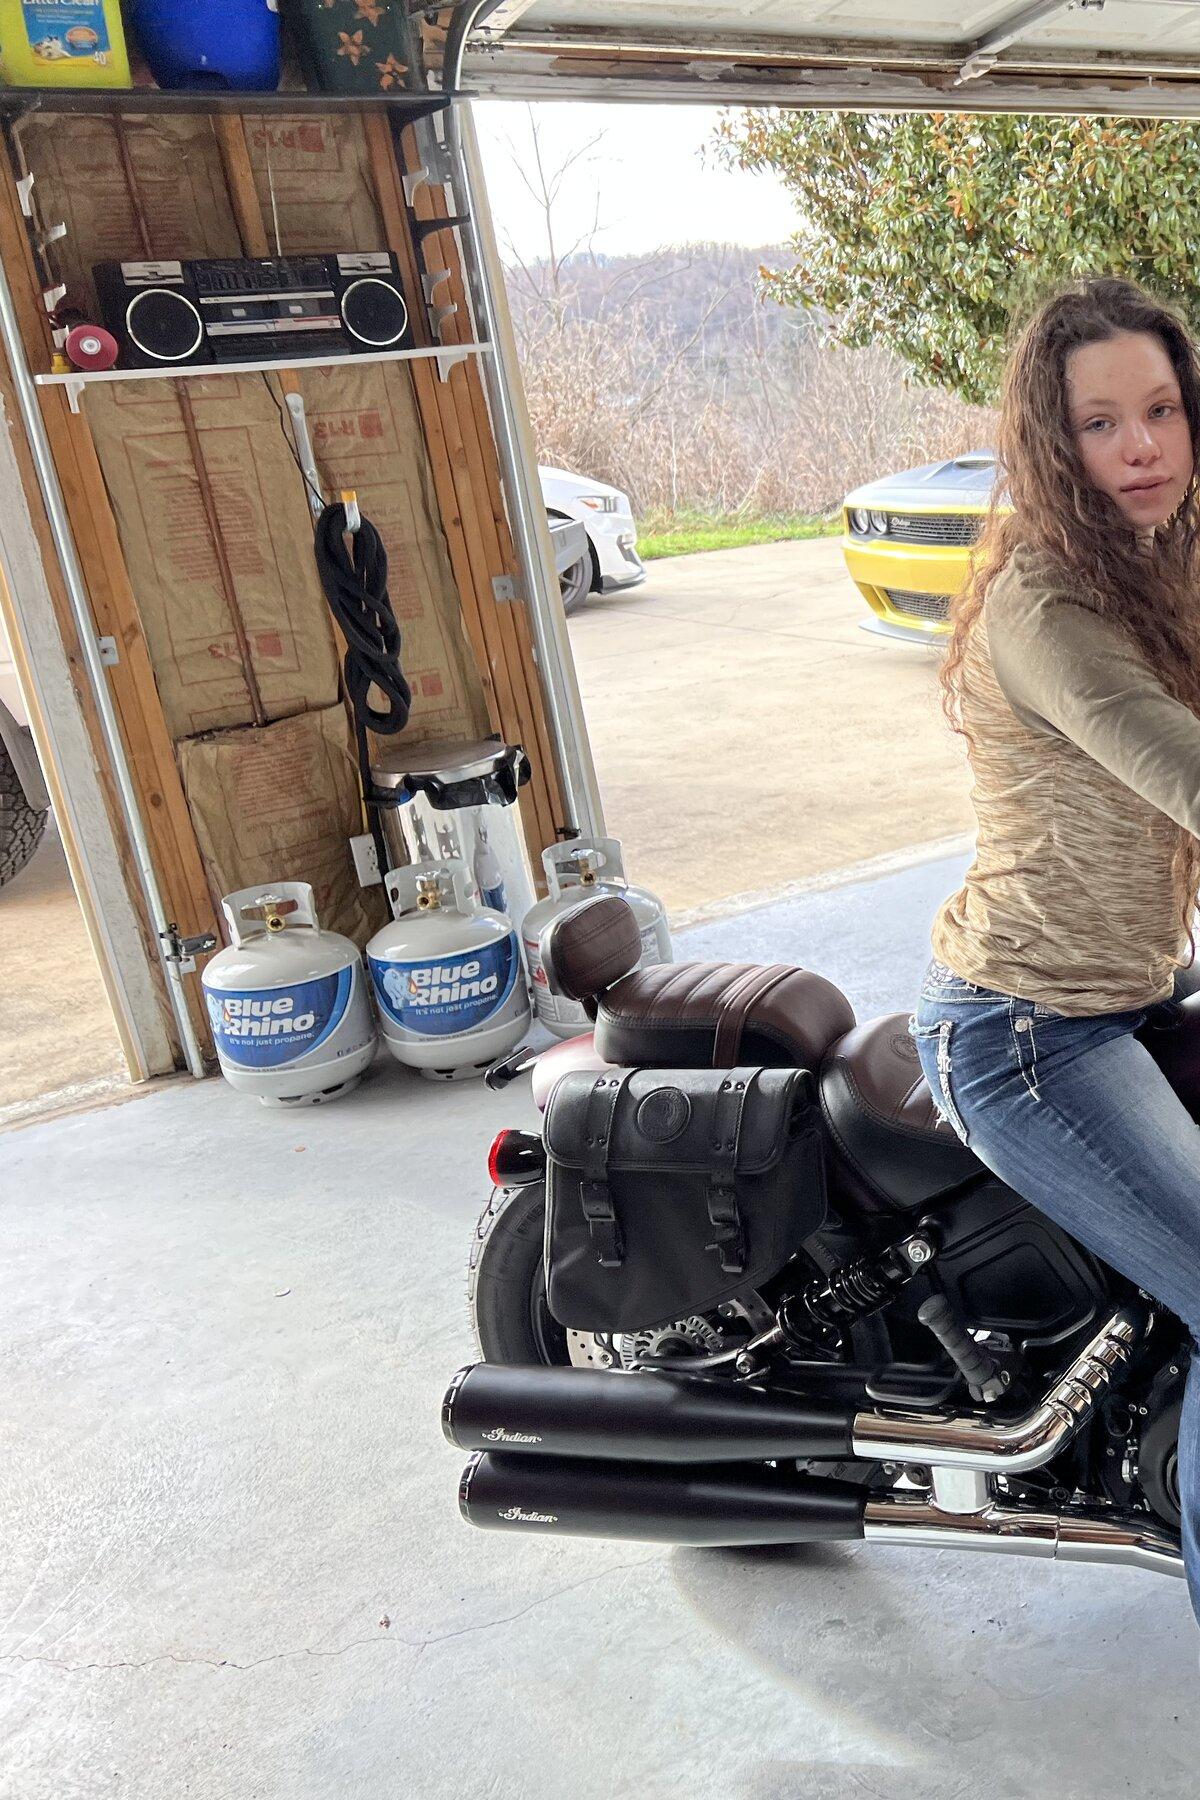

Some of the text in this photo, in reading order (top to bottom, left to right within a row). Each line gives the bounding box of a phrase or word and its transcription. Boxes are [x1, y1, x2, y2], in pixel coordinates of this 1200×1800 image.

[410, 960, 481, 987] Blue
[409, 975, 498, 1007] Rhino
[224, 997, 294, 1017] Blue
[430, 1006, 444, 1015] not
[445, 1003, 463, 1014] just
[224, 1013, 315, 1036] Rhino
[255, 1038, 273, 1046] just
[486, 1427, 539, 1444] Indian
[502, 1506, 554, 1523] Indian
